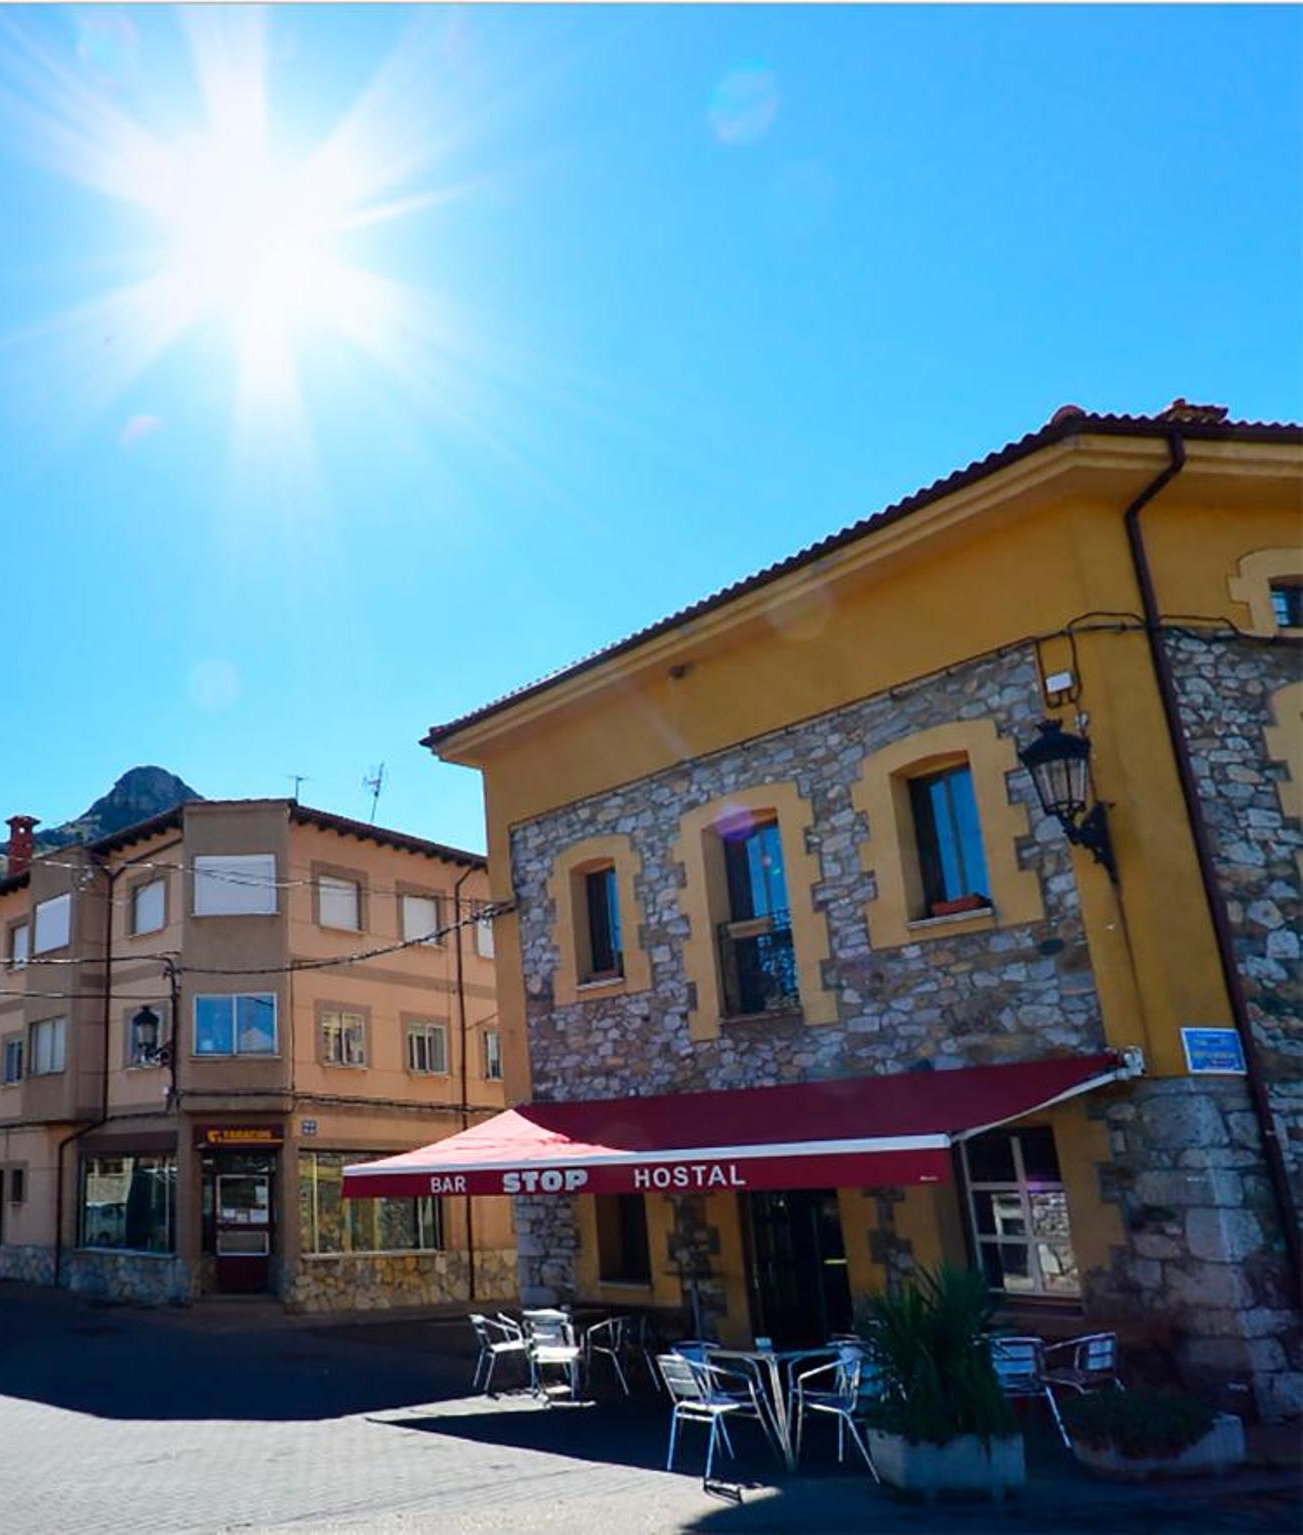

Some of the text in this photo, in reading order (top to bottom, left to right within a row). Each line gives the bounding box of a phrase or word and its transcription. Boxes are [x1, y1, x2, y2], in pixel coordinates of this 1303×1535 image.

[430, 1164, 746, 1194] BAR STOP HOSTAL
